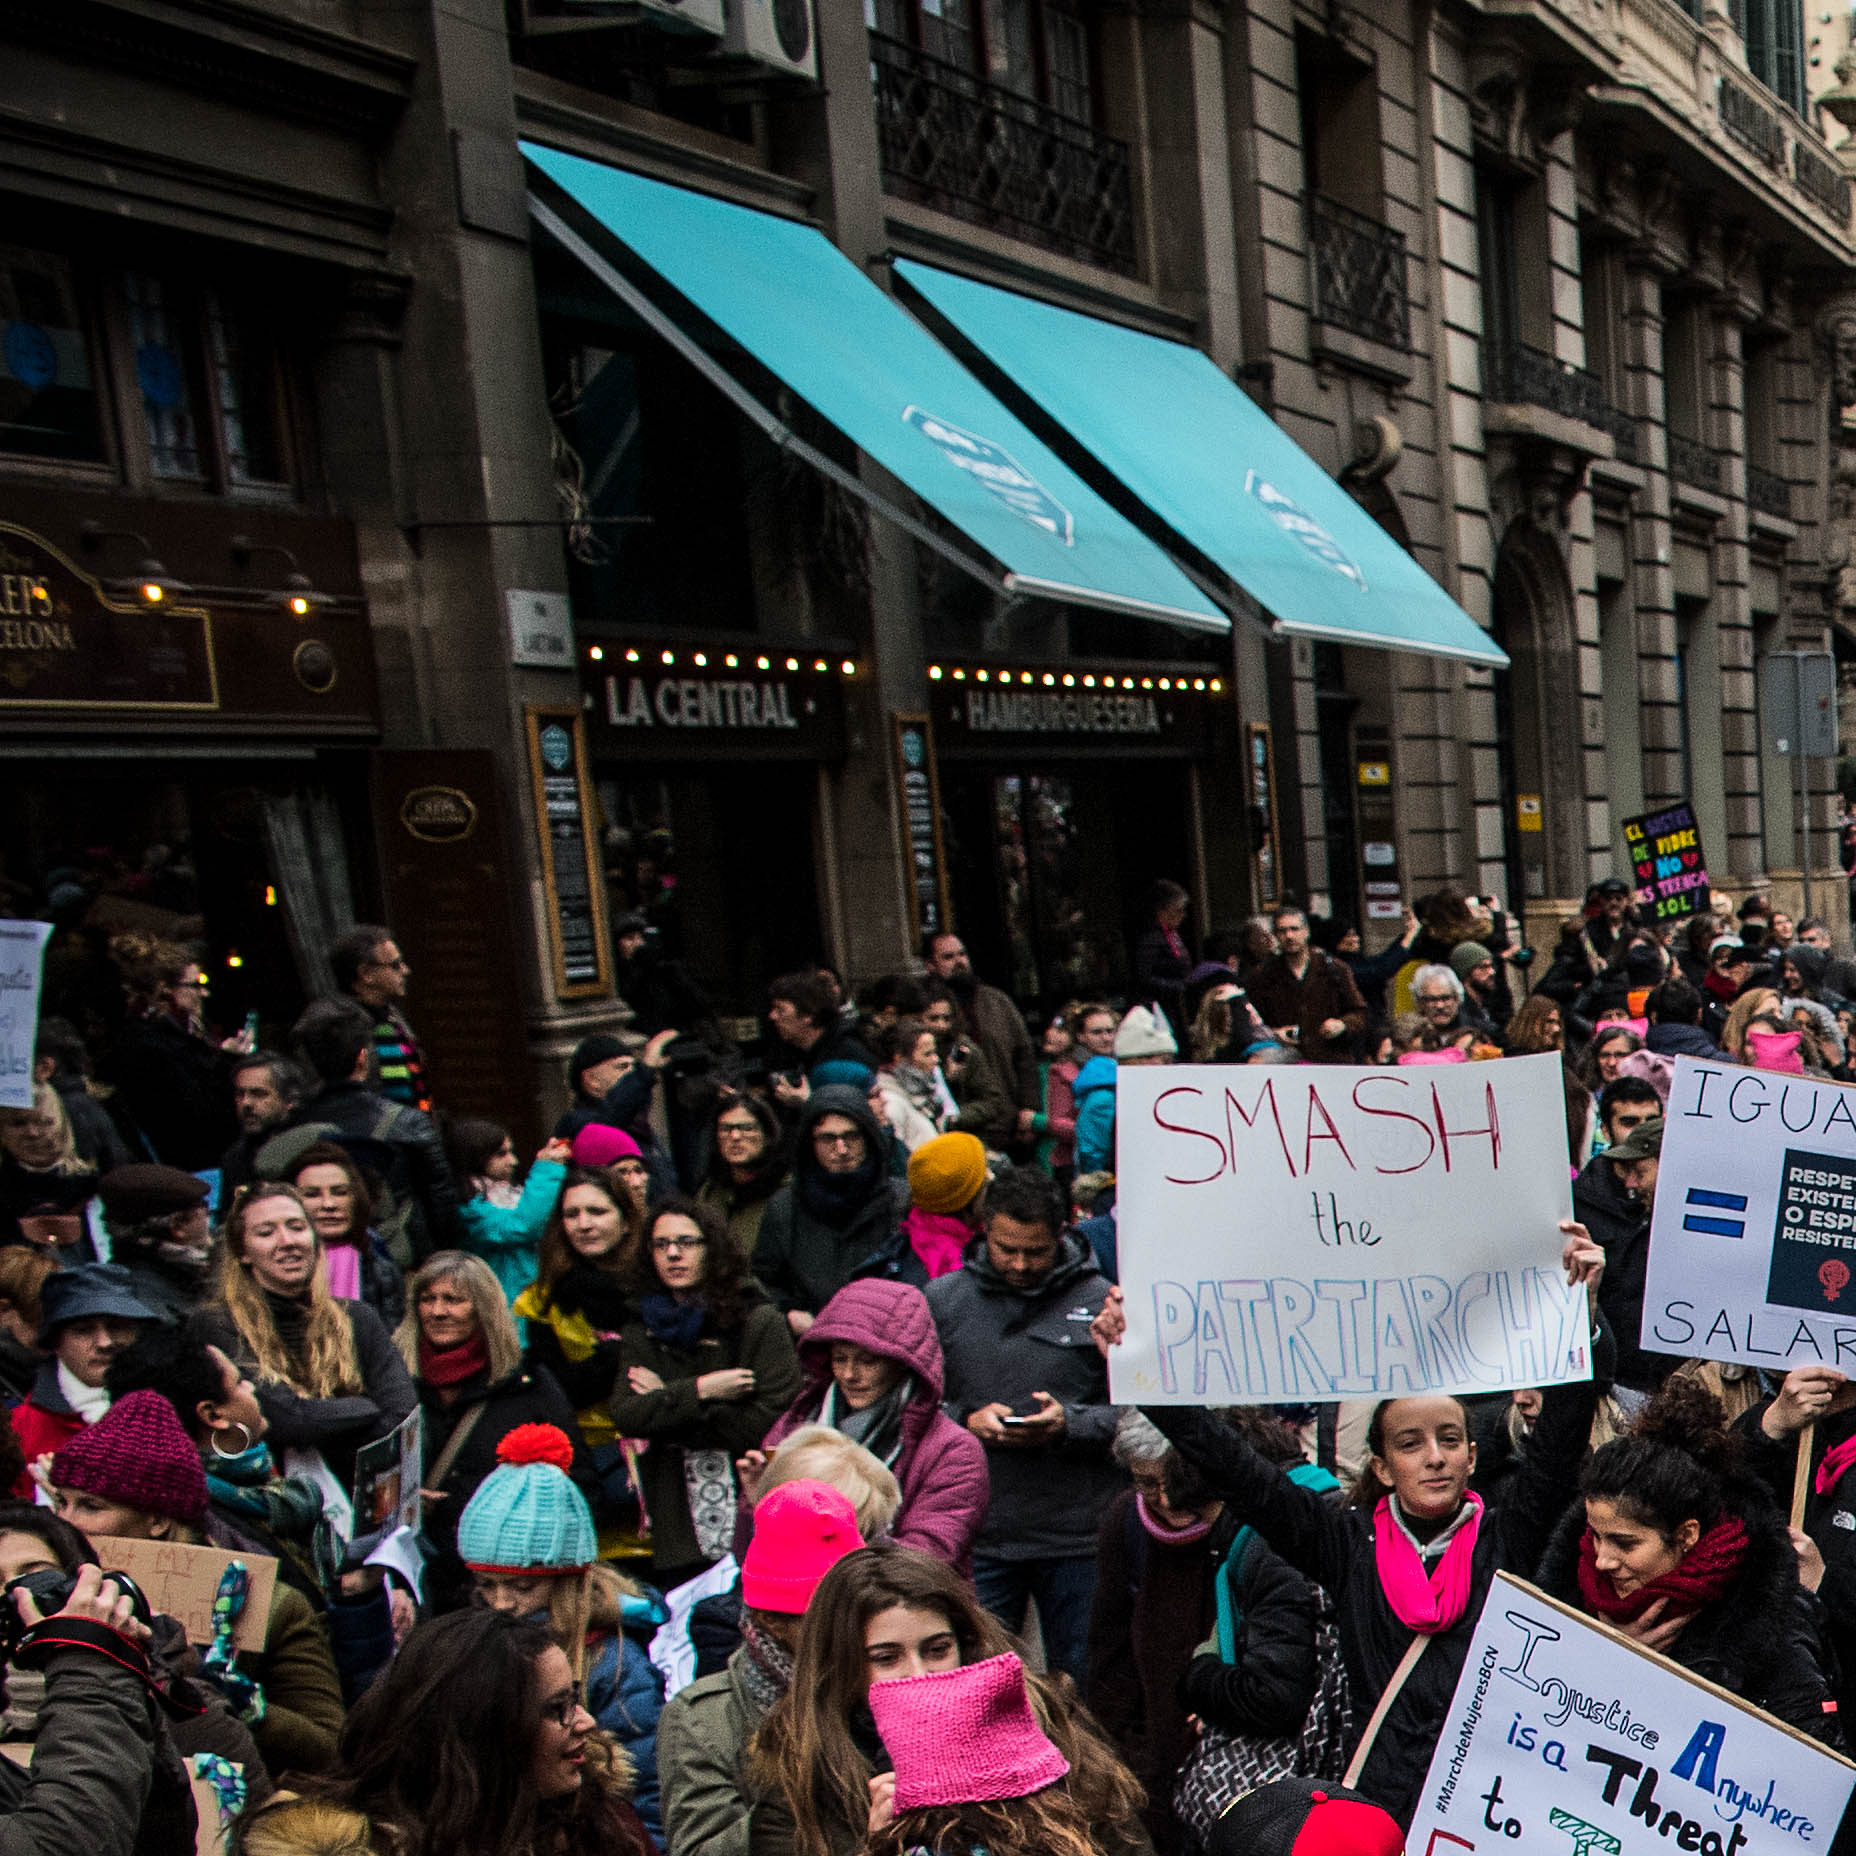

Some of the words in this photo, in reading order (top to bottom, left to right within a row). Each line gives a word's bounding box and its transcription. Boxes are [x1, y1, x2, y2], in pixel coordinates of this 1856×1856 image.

[606, 675, 654, 727] LA
[655, 678, 799, 729] CENTRAL
[966, 690, 1161, 733] HAMBURGUESERIA
[1633, 843, 1650, 862] DE
[1656, 828, 1697, 856] VIDRE
[1656, 855, 1683, 879] NO
[1151, 1074, 1503, 1185] SMASH
[1311, 1191, 1383, 1247] the
[1785, 1206, 1805, 1224] O
[1151, 1265, 1585, 1396] PATRIARCHY
[1435, 1643, 1500, 1814] #MarchdeMujeresBCN
[1499, 1610, 1660, 1752] Injustice
[1669, 1719, 1815, 1843] Anywhere
[1506, 1712, 1538, 1753] is
[1541, 1738, 1568, 1773] a
[1480, 1775, 1522, 1840] to
